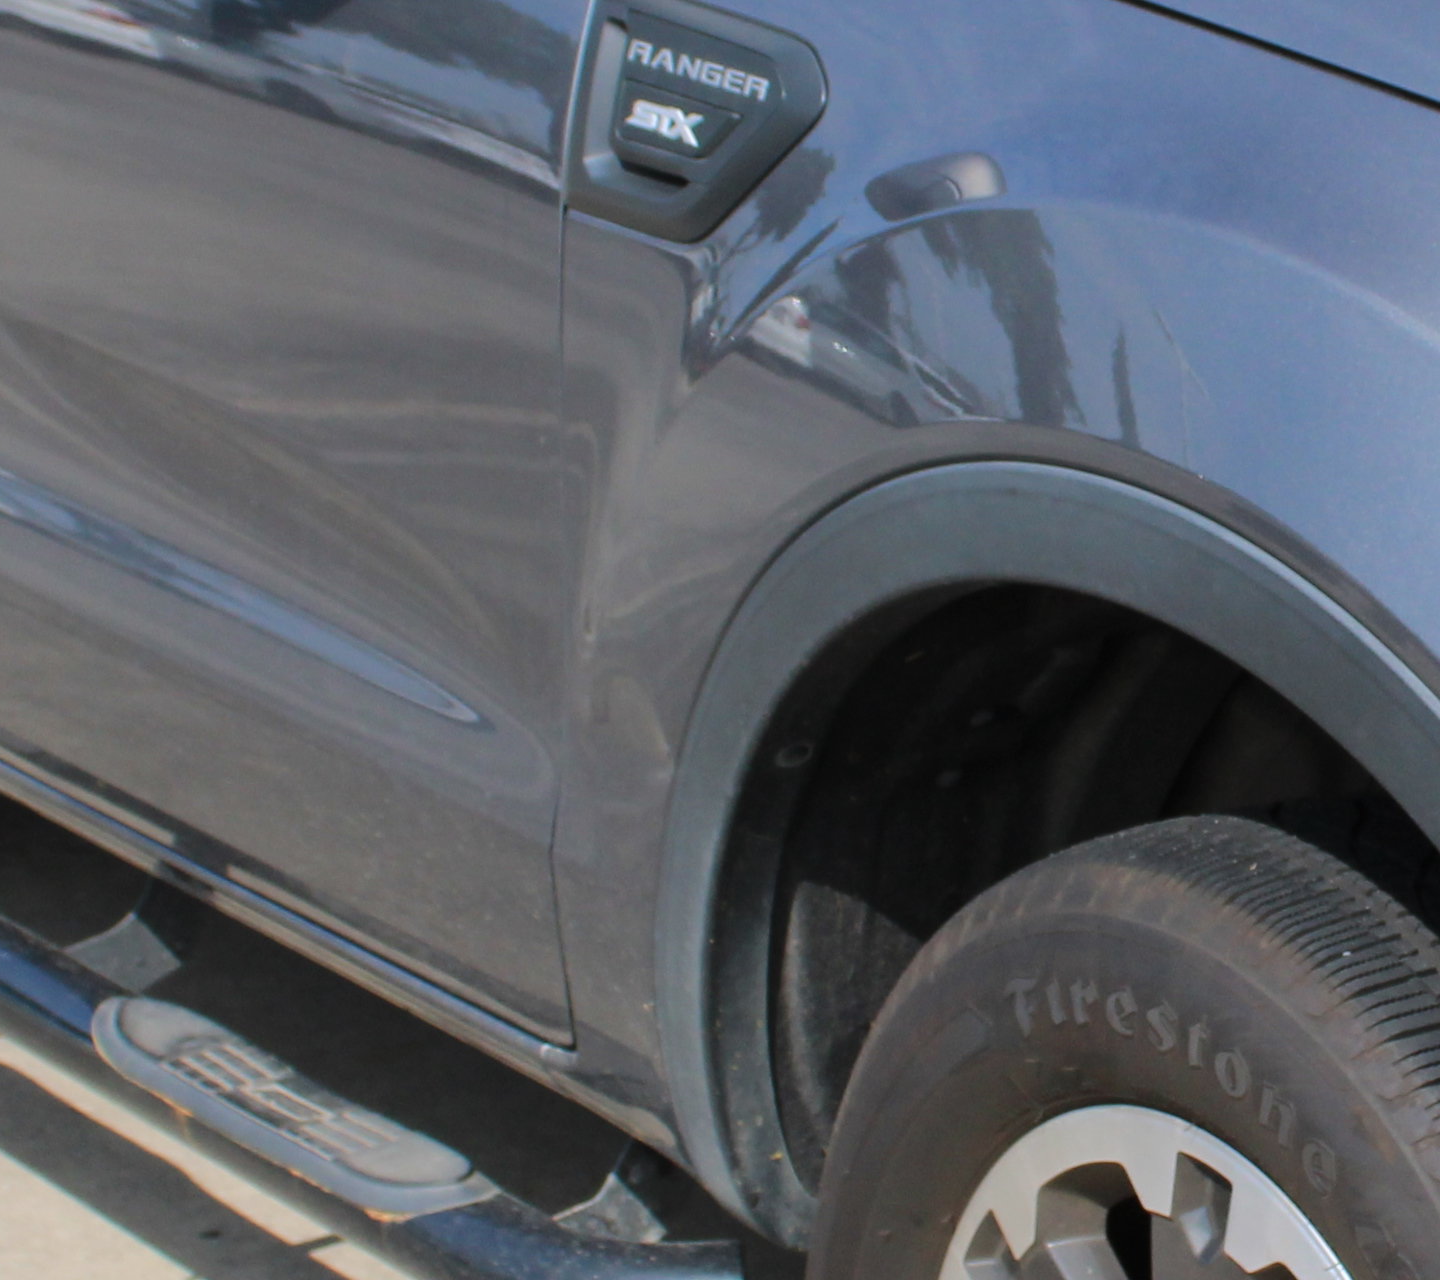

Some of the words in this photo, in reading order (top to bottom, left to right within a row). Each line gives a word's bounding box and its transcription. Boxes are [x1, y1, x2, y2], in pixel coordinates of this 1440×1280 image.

[626, 38, 770, 102] RANGER
[624, 99, 704, 148] STX
[1003, 975, 1338, 1199] Firestone
